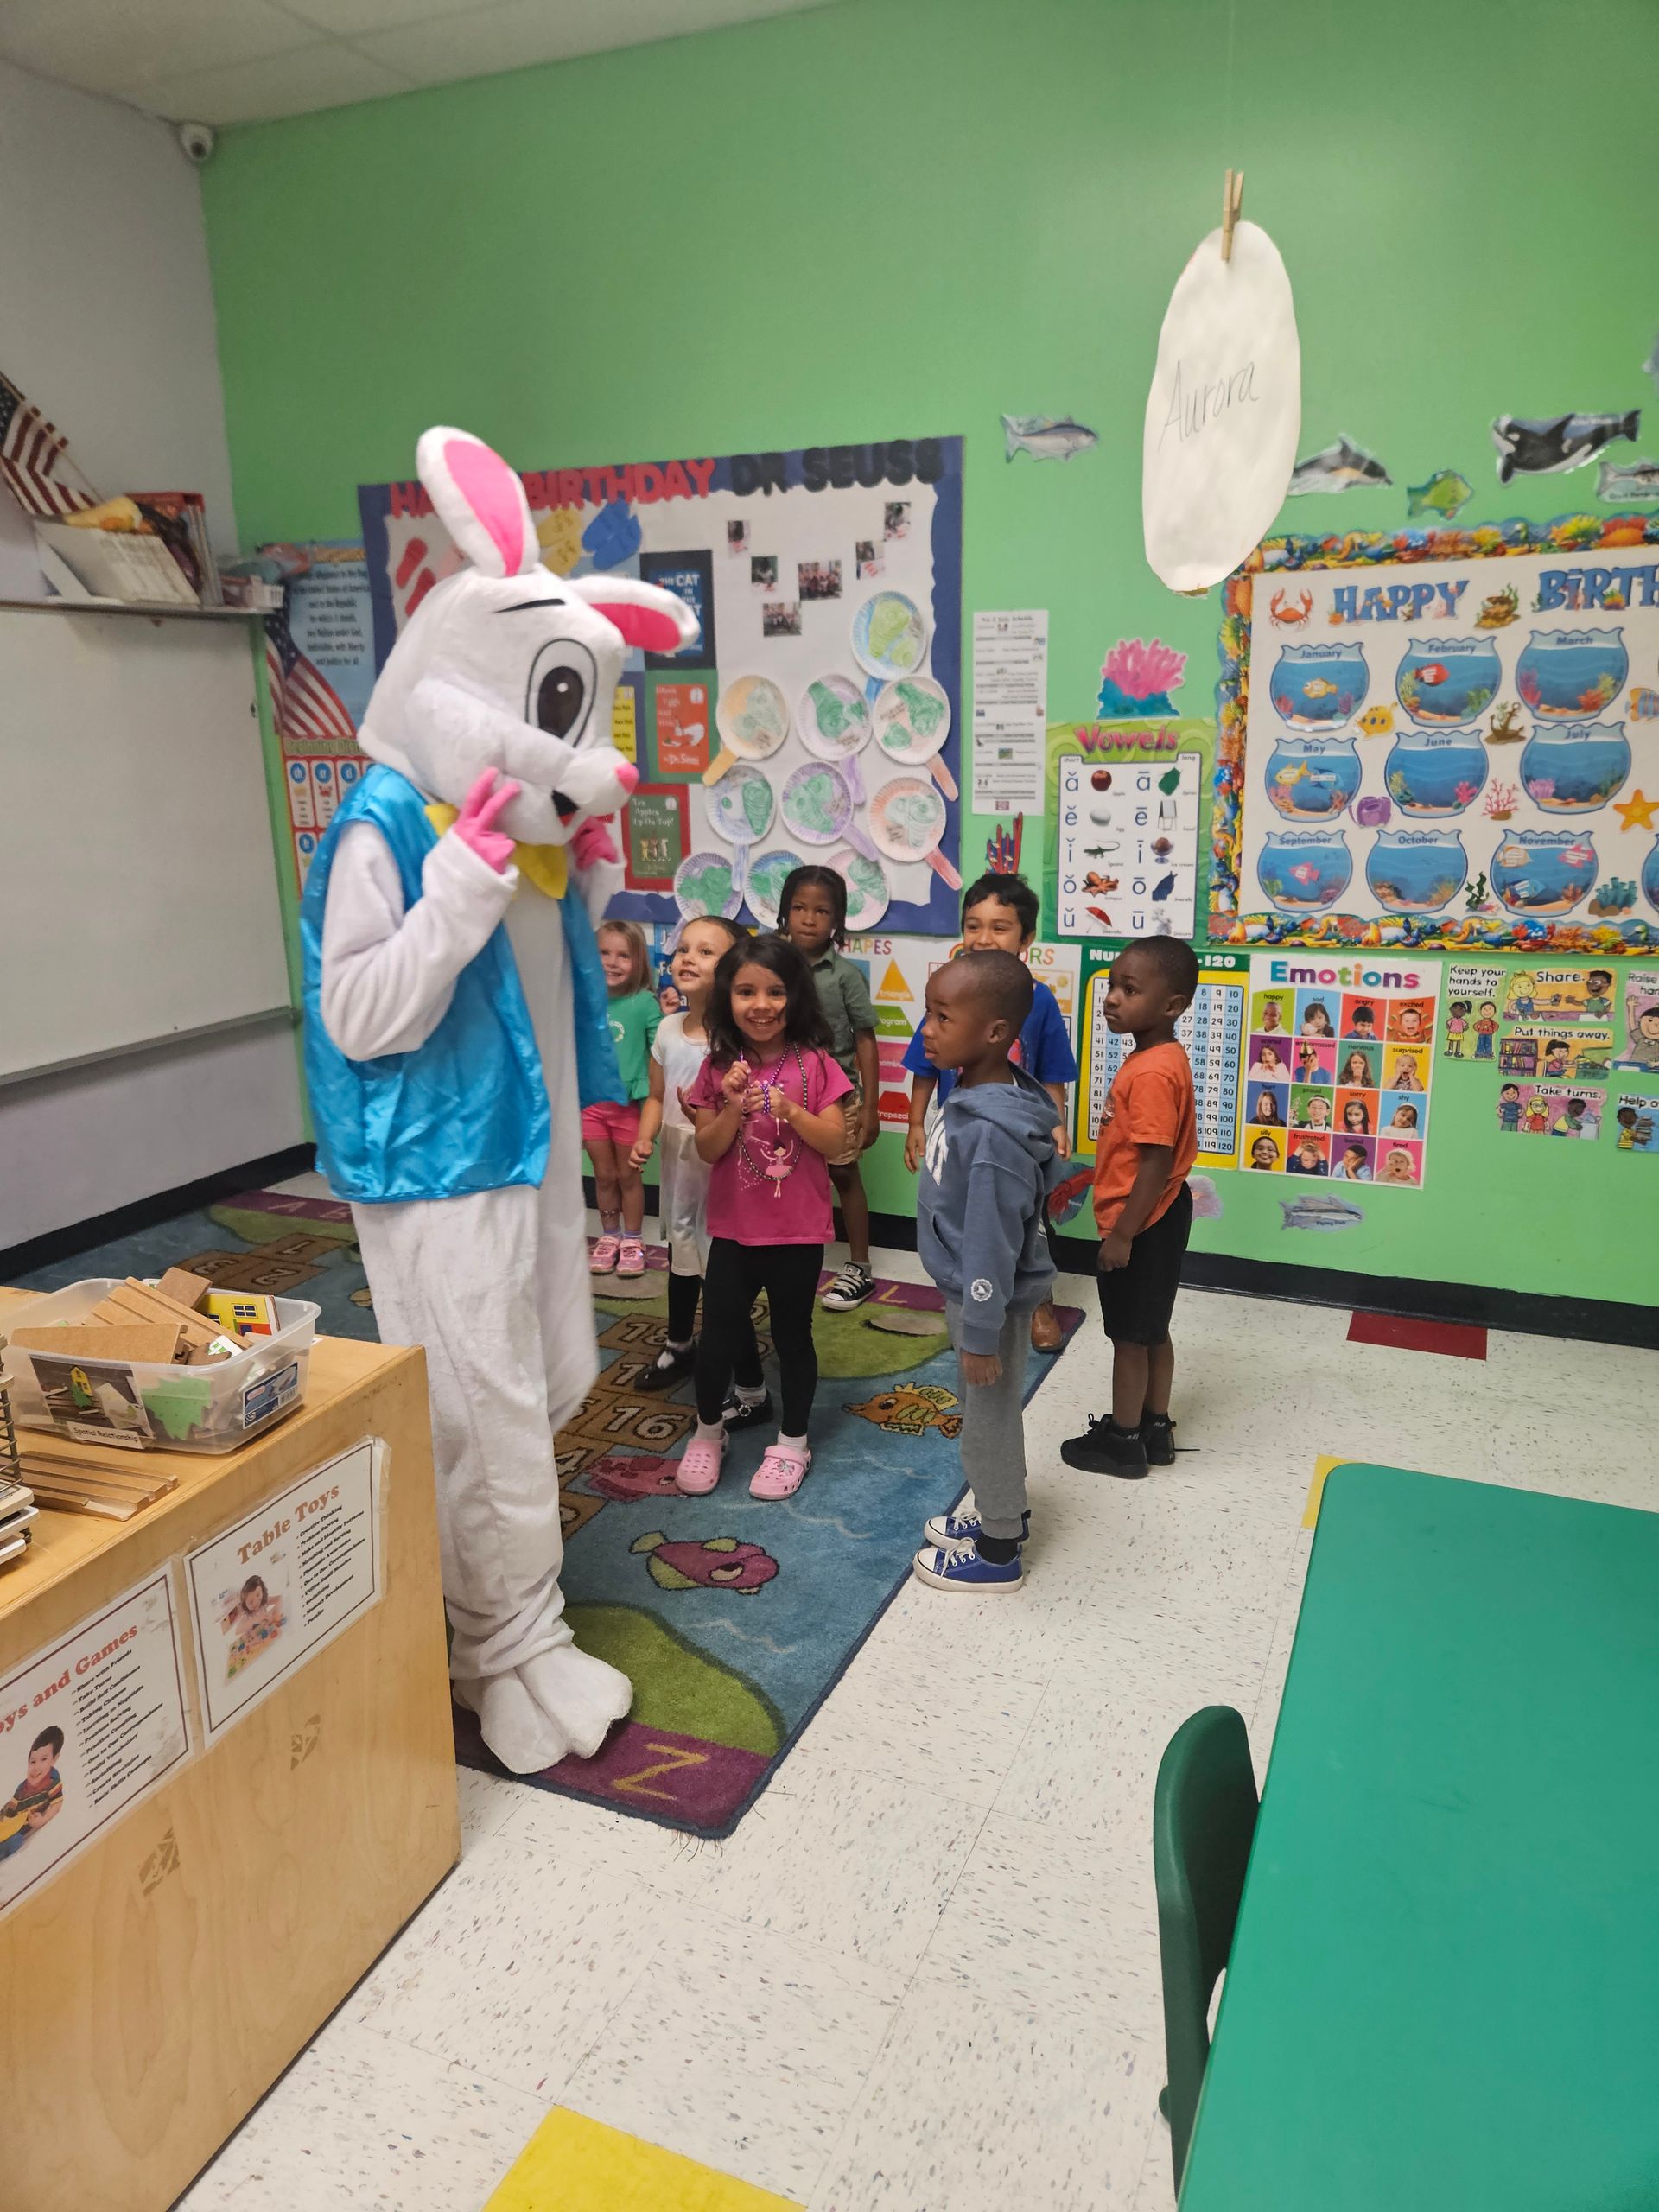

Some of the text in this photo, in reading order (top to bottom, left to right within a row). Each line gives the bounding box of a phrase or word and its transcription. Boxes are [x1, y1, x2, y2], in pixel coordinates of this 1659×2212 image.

[1158, 359, 1260, 452] Aurora
[803, 437, 944, 493] SEUSS
[676, 574, 700, 587] CAT
[1332, 581, 1470, 624] HAPPY
[1300, 634, 1594, 661] January February March
[1074, 725, 1180, 754] Vowels
[1303, 728, 1591, 756] May June July
[1278, 836, 1575, 848] September October November
[839, 939, 892, 955] HAPES
[1270, 960, 1421, 990] Emotions
[1450, 965, 1478, 976] Keep
[1536, 971, 1585, 983] Share.
[1449, 976, 1481, 986] hands
[1628, 973, 1657, 984] Raise
[1448, 986, 1496, 997] yourself.
[1213, 1003, 1223, 1012] 19
[1514, 1027, 1610, 1041] Put things away.
[1210, 1046, 1221, 1054] 49
[1208, 1073, 1219, 1082] 69
[1535, 1085, 1601, 1099] Take turns.
[1206, 1099, 1217, 1108] 89
[1619, 1096, 1646, 1108] Help
[878, 1109, 909, 1121] trapezoi
[1093, 1103, 1102, 1111] 91
[1206, 1114, 1217, 1122] 99
[1204, 1127, 1217, 1135] 109
[1204, 1141, 1217, 1149] 119
[606, 1406, 684, 1440] 16
[97, 1431, 138, 1443] Relationship
[321, 1505, 342, 1522] Thinking
[237, 1485, 340, 1565] Table Toys
[33, 1669, 71, 1708] and
[75, 1624, 138, 1675] Games
[612, 1744, 709, 1799] Z
